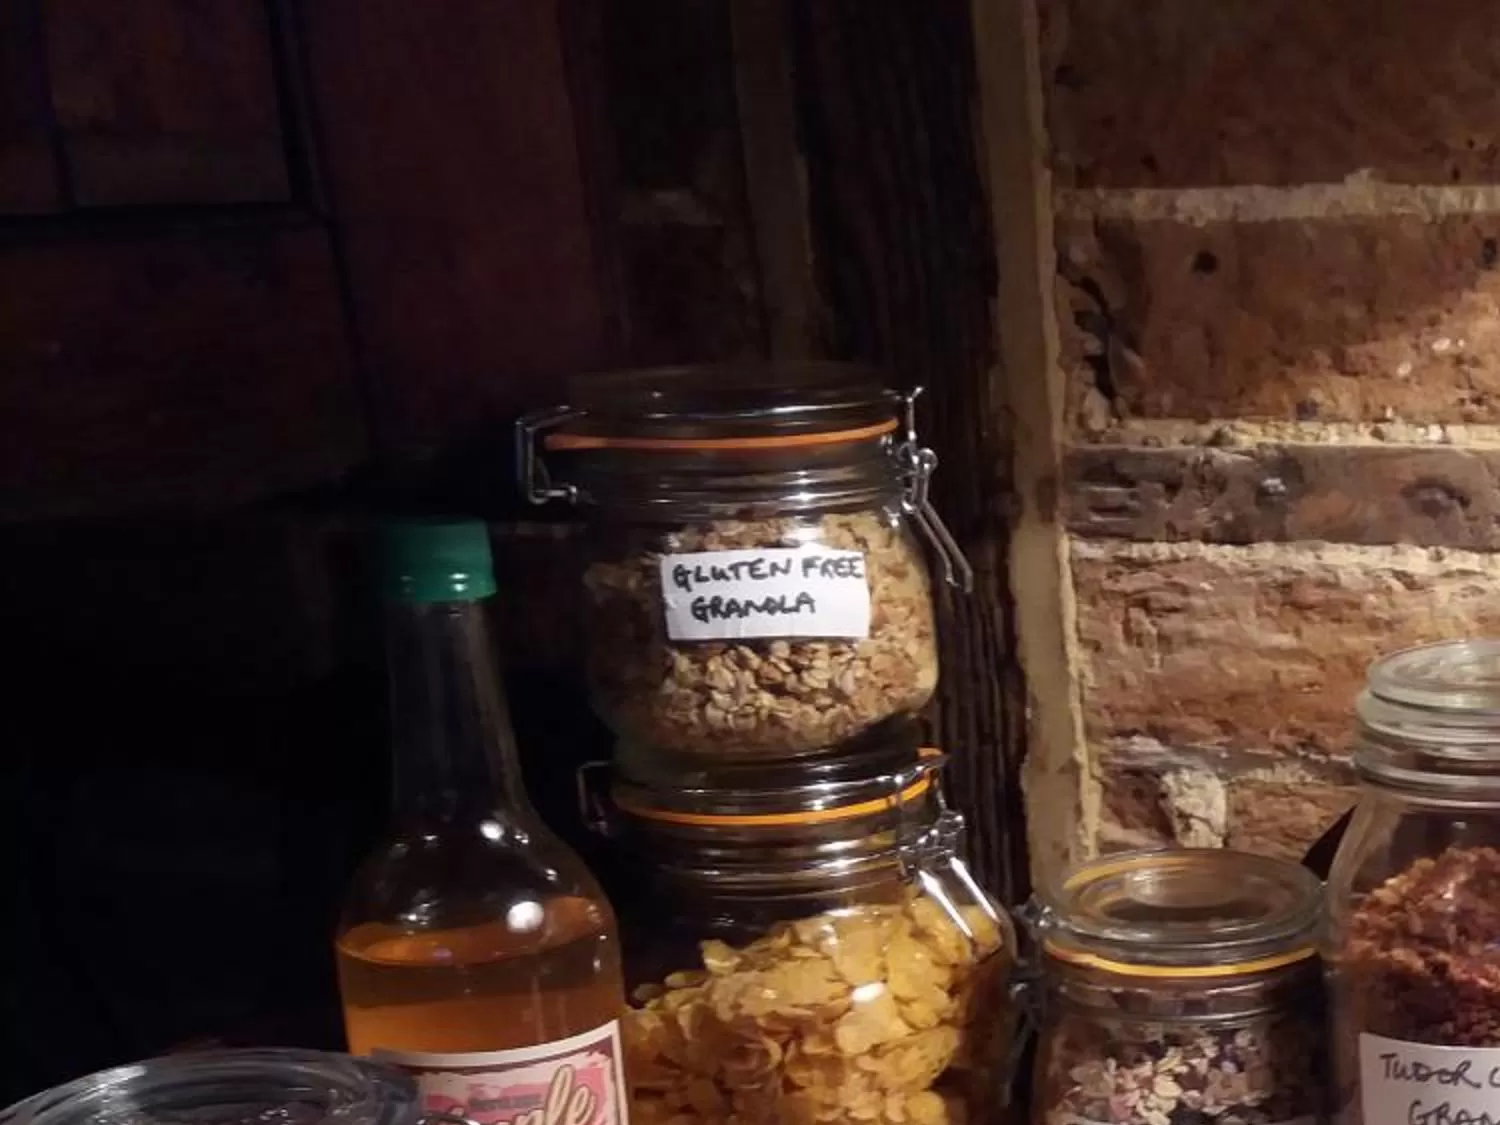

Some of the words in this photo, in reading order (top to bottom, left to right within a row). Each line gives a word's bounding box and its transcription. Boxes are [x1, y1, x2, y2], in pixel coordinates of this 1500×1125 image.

[672, 557, 792, 592] GLUTEN
[801, 555, 864, 580] FREE
[690, 591, 816, 624] GRANOLA
[1378, 1052, 1482, 1089] TUDOR
